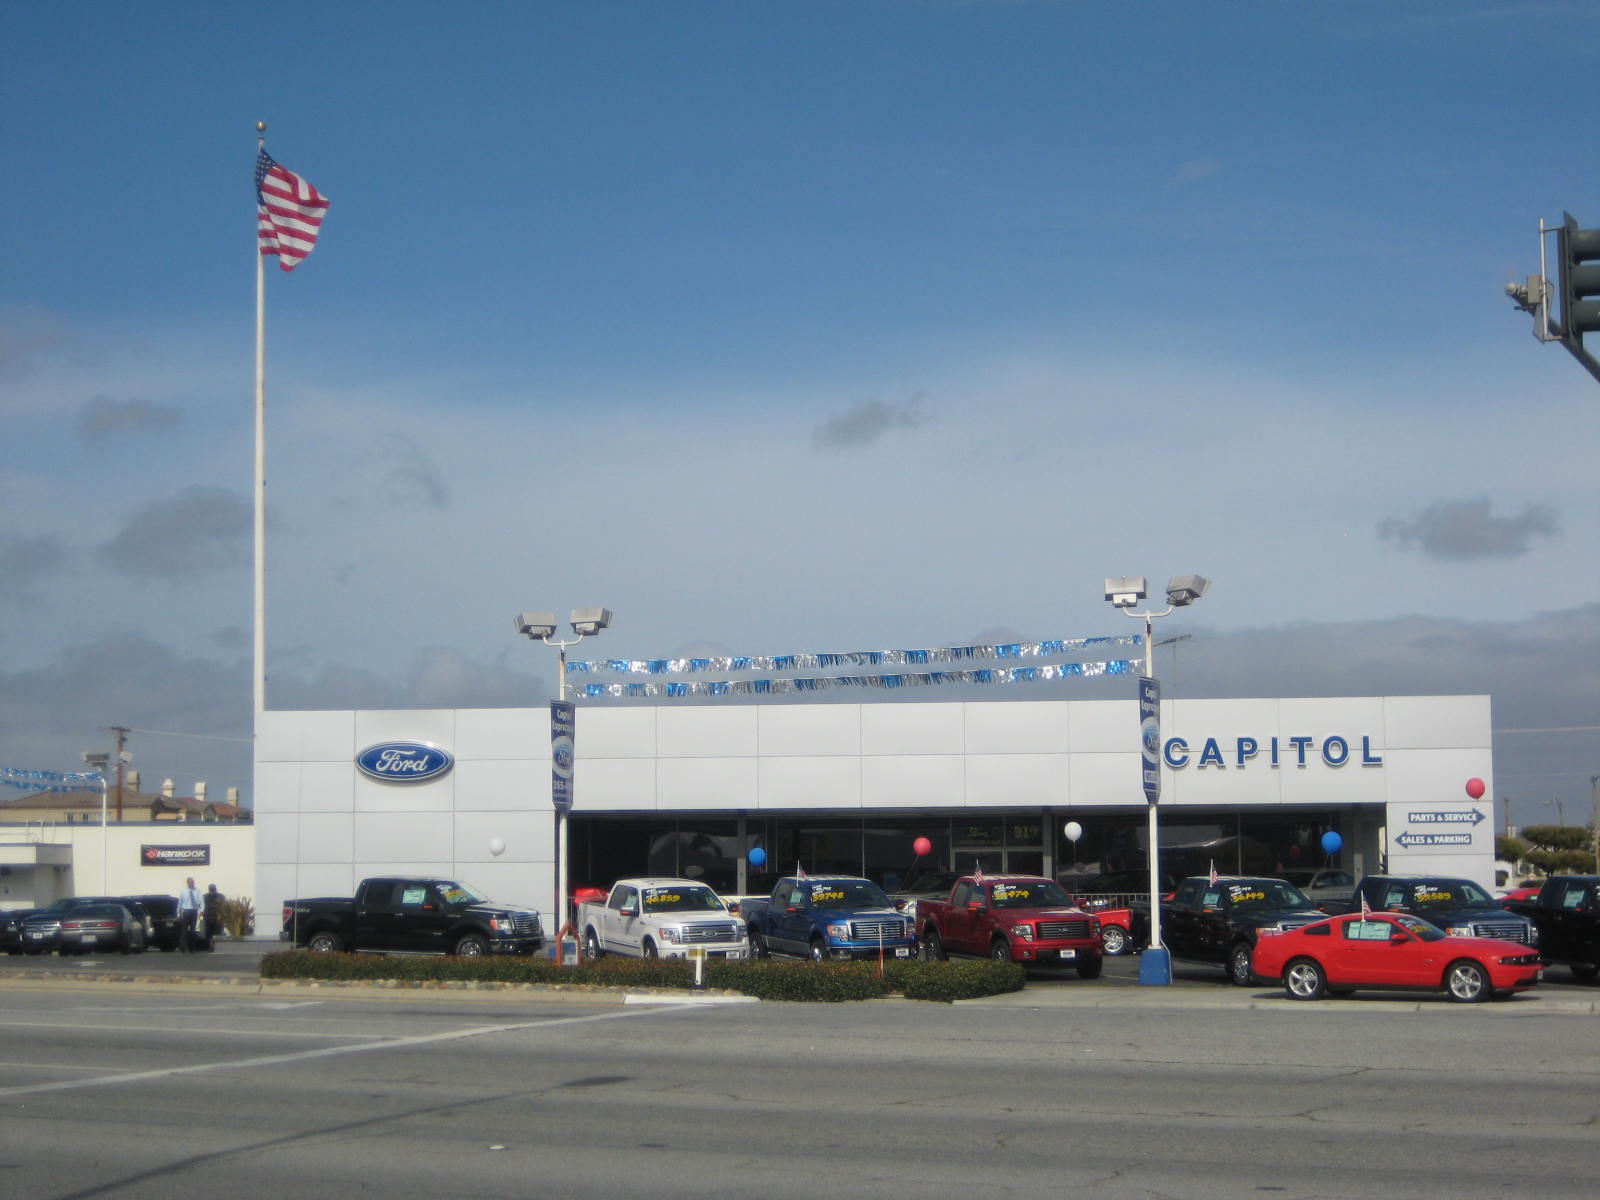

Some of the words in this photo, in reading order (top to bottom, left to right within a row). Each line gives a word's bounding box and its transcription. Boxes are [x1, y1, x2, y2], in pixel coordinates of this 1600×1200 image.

[1163, 735, 1384, 769] CAPITOL
[375, 749, 430, 772] Ford
[1410, 813, 1436, 822] PARTS
[1437, 813, 1443, 822] &
[1444, 812, 1478, 822] SERVICE
[1401, 836, 1425, 845] SALES
[1426, 836, 1433, 844] &
[1434, 835, 1470, 844] PARKING
